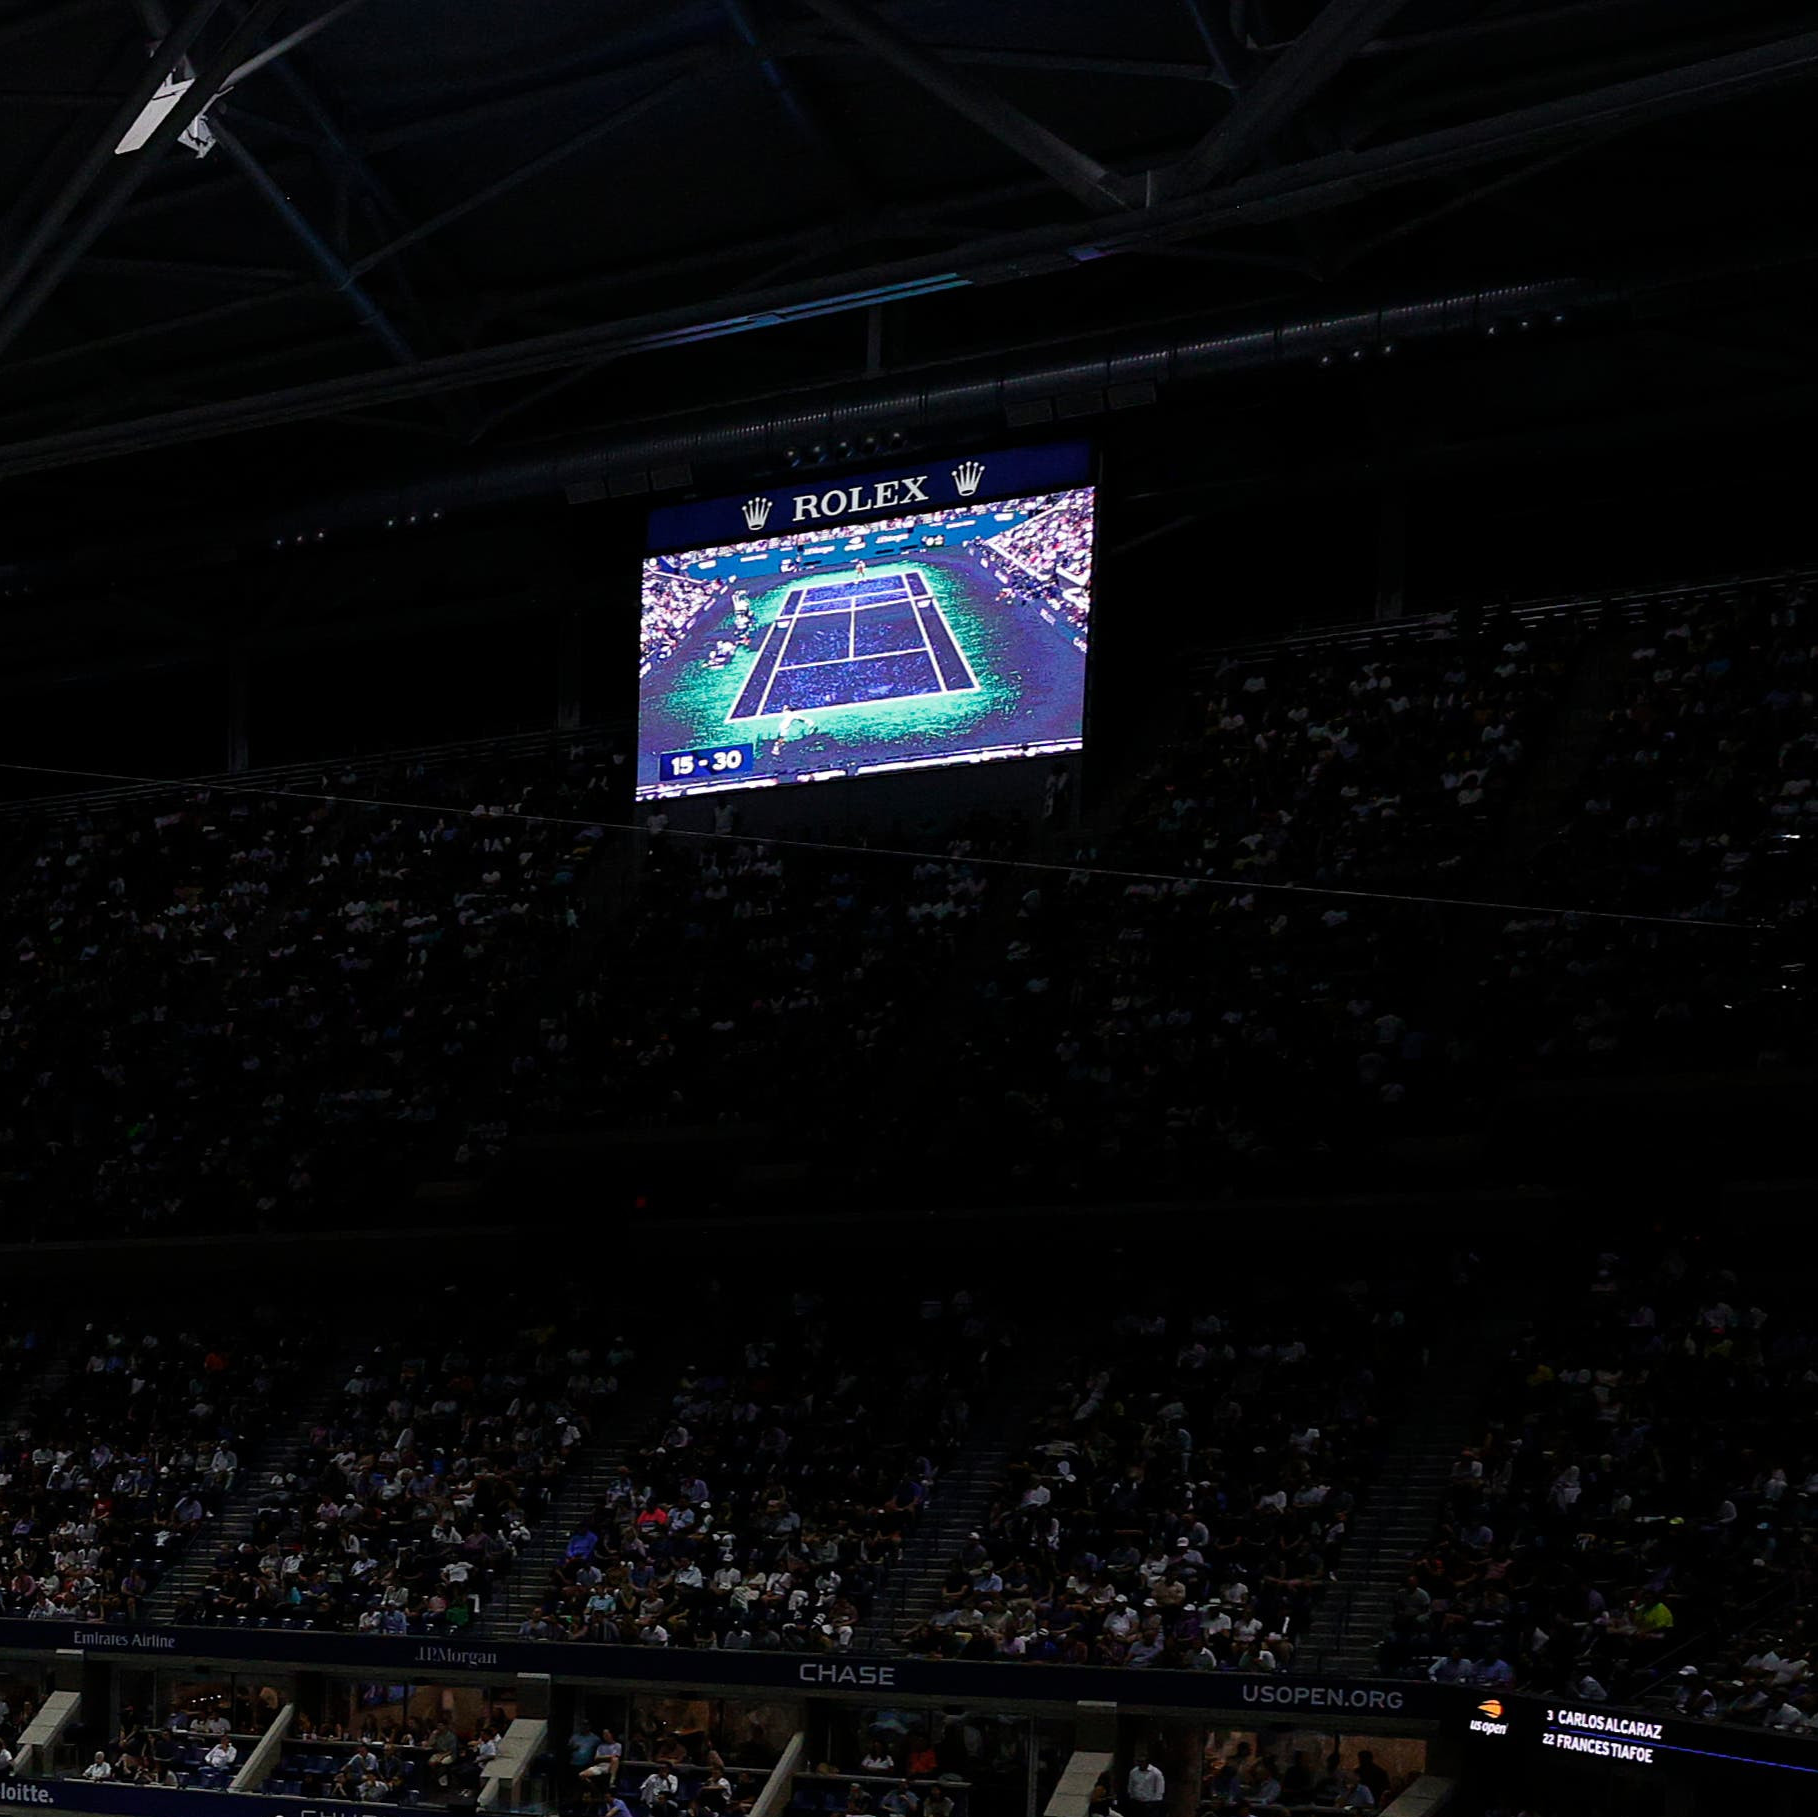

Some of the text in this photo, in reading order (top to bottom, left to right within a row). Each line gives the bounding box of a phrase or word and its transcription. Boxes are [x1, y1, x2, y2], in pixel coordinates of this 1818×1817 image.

[793, 475, 929, 521] ROLEX
[670, 754, 696, 775] 15
[712, 749, 742, 770] 30
[73, 1629, 176, 1649] Emirates Airline
[415, 1646, 498, 1666] J.P.Morgan
[799, 1662, 896, 1687] CHASE
[1241, 1684, 1403, 1710] USOPEN.ORG
[1558, 1710, 1606, 1730] CARLOS
[1606, 1718, 1663, 1740] ALCARAZ
[1542, 1733, 1653, 1763] 22 FRANCES TIAFOE
